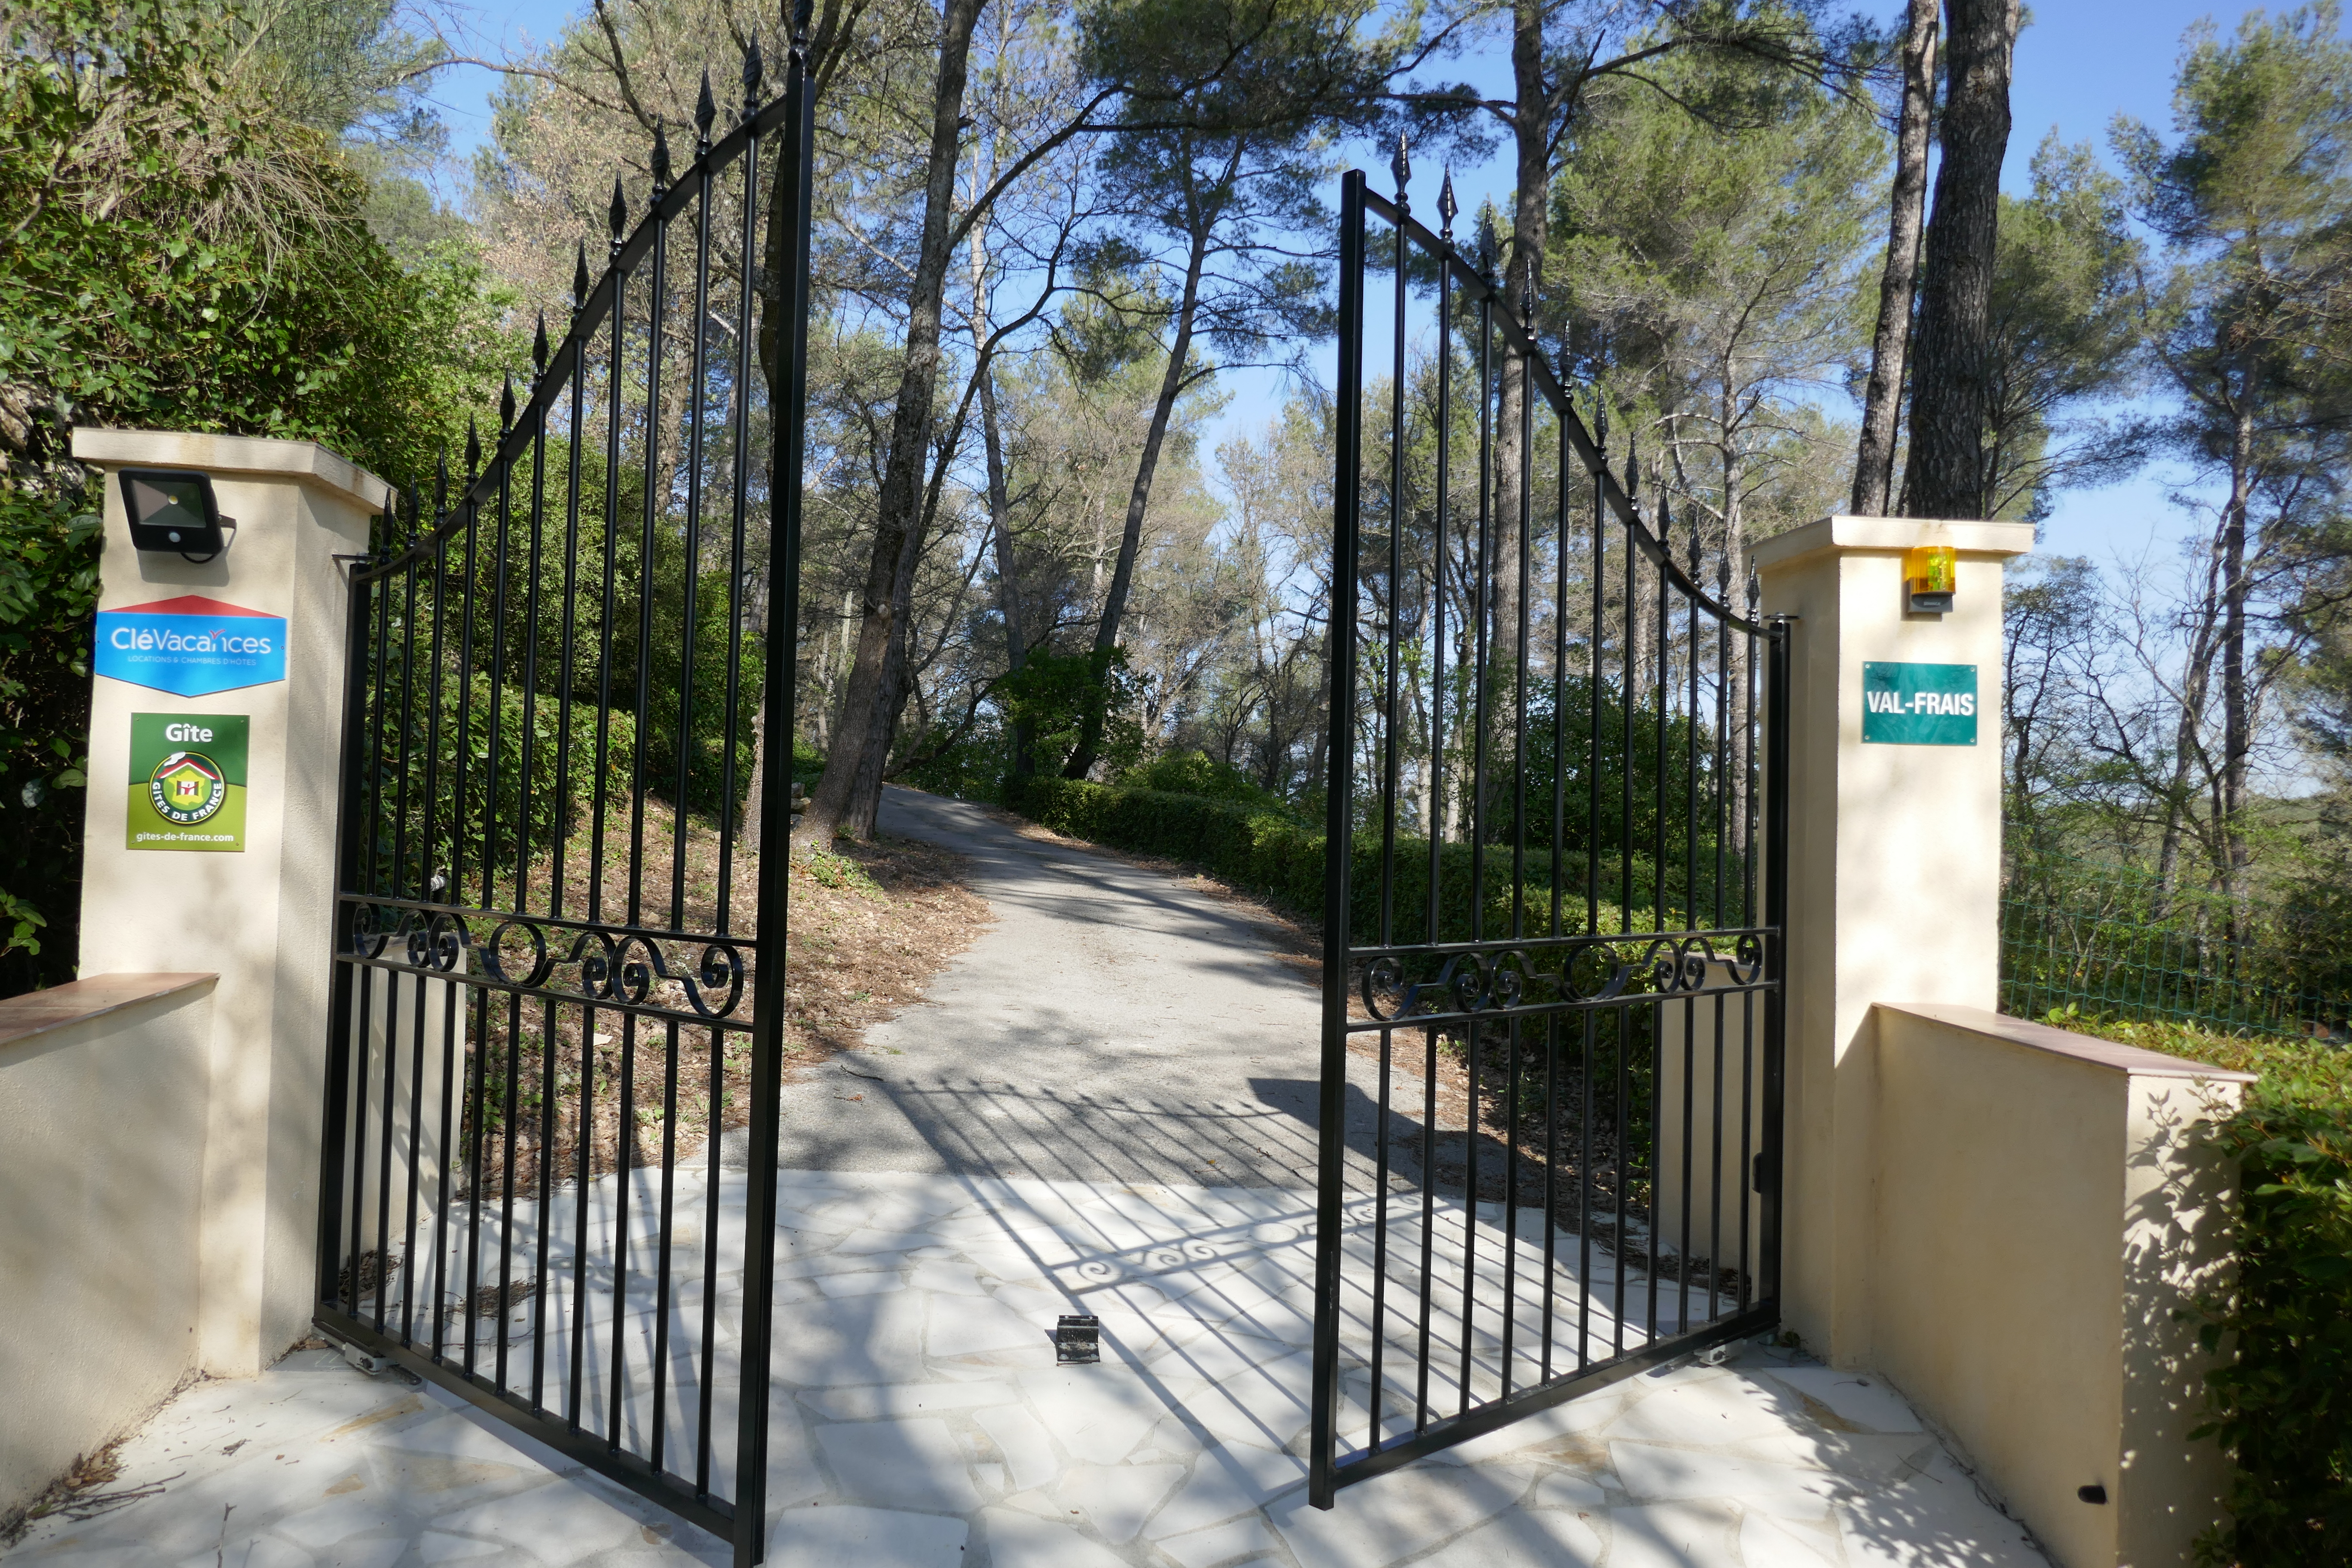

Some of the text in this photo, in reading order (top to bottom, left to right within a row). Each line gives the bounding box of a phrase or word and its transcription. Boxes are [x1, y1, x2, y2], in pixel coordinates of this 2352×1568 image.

[1867, 691, 1974, 716] VAL-FRAIS
[165, 723, 213, 742] Gîte
[172, 811, 188, 821] DE
[193, 783, 222, 820] FRANCE
